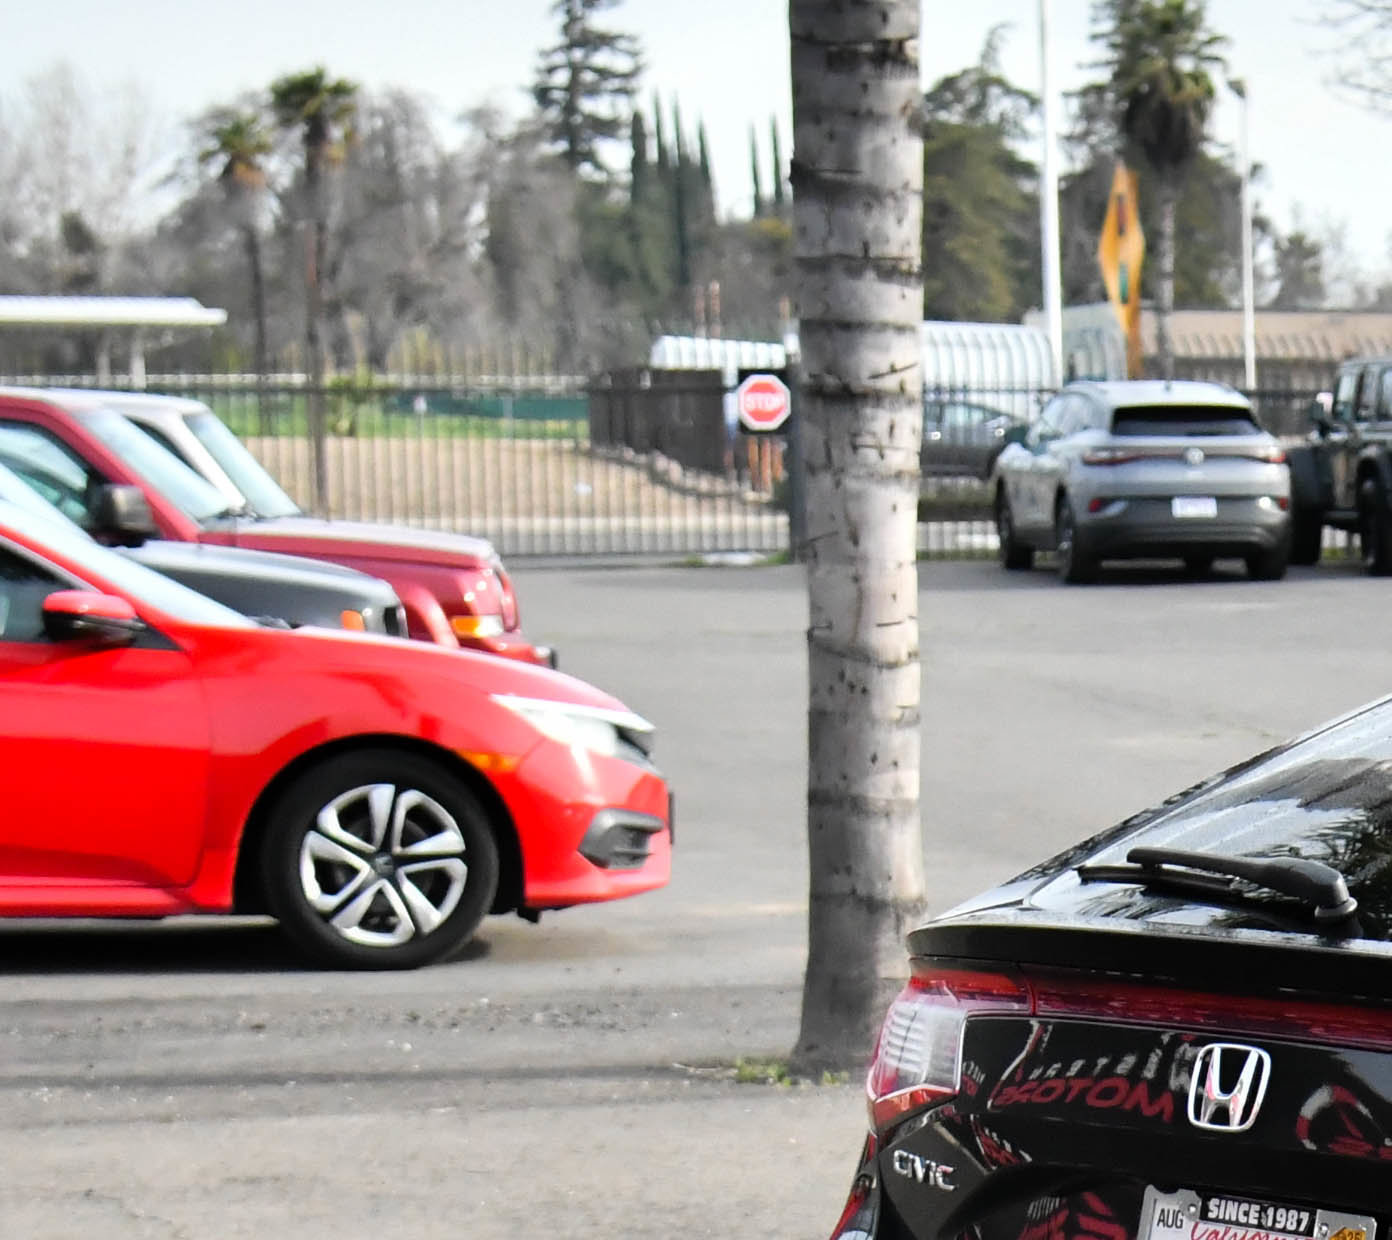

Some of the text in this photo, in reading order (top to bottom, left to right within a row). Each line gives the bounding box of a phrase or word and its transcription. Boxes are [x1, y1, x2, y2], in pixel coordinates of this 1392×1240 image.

[743, 391, 785, 412] STOP
[894, 1150, 957, 1191] CIVIC
[1157, 1209, 1184, 1229] AUG
[1208, 1198, 1309, 1232] SINCE 1987
